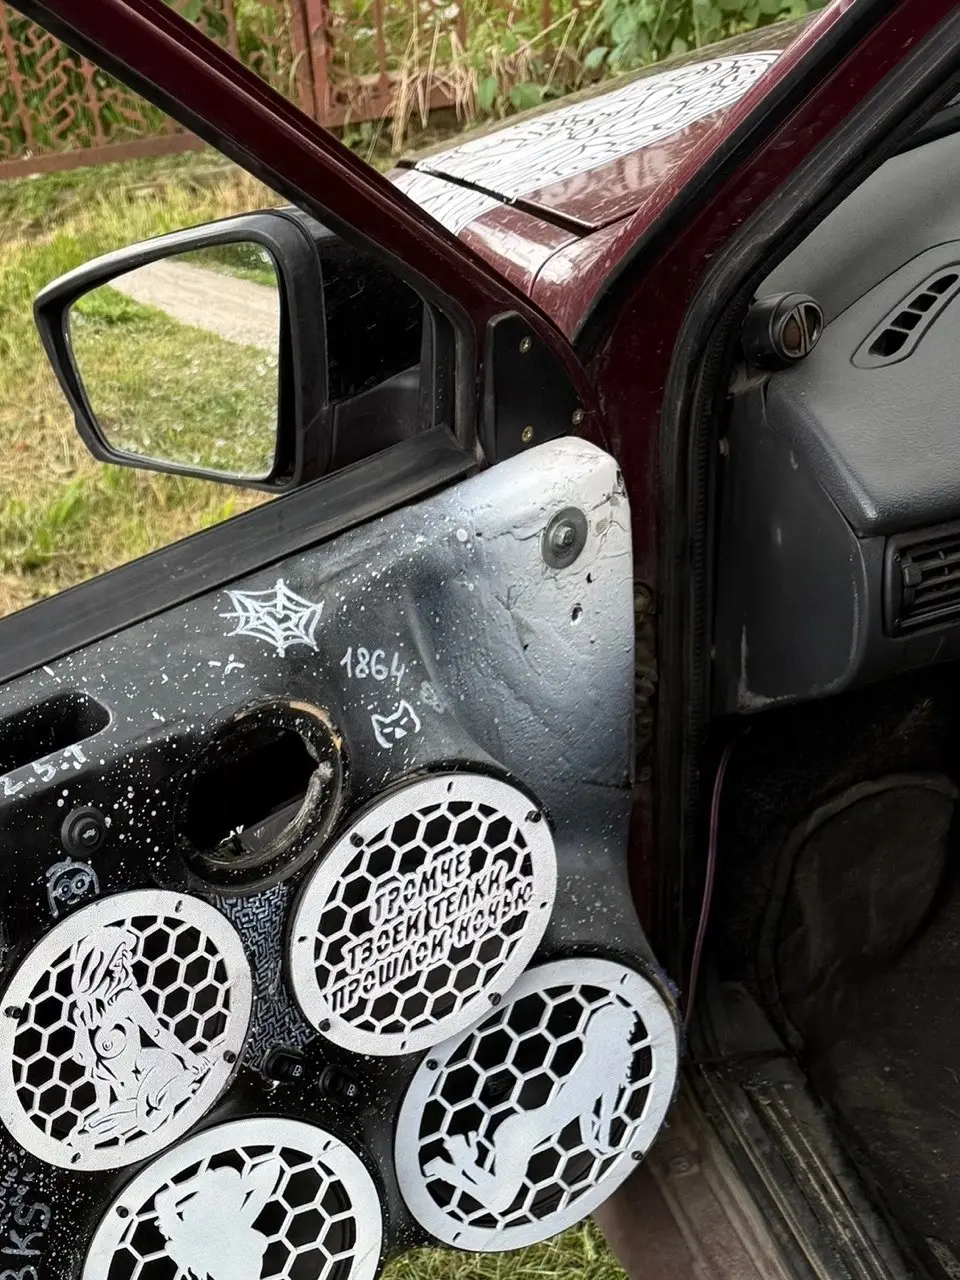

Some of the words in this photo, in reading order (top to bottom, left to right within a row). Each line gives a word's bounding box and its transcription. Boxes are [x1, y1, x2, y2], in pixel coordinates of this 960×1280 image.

[340, 646, 405, 687] 1864
[373, 849, 468, 923] ГРОМЧЕ
[455, 881, 534, 943] НОЧЬЮ
